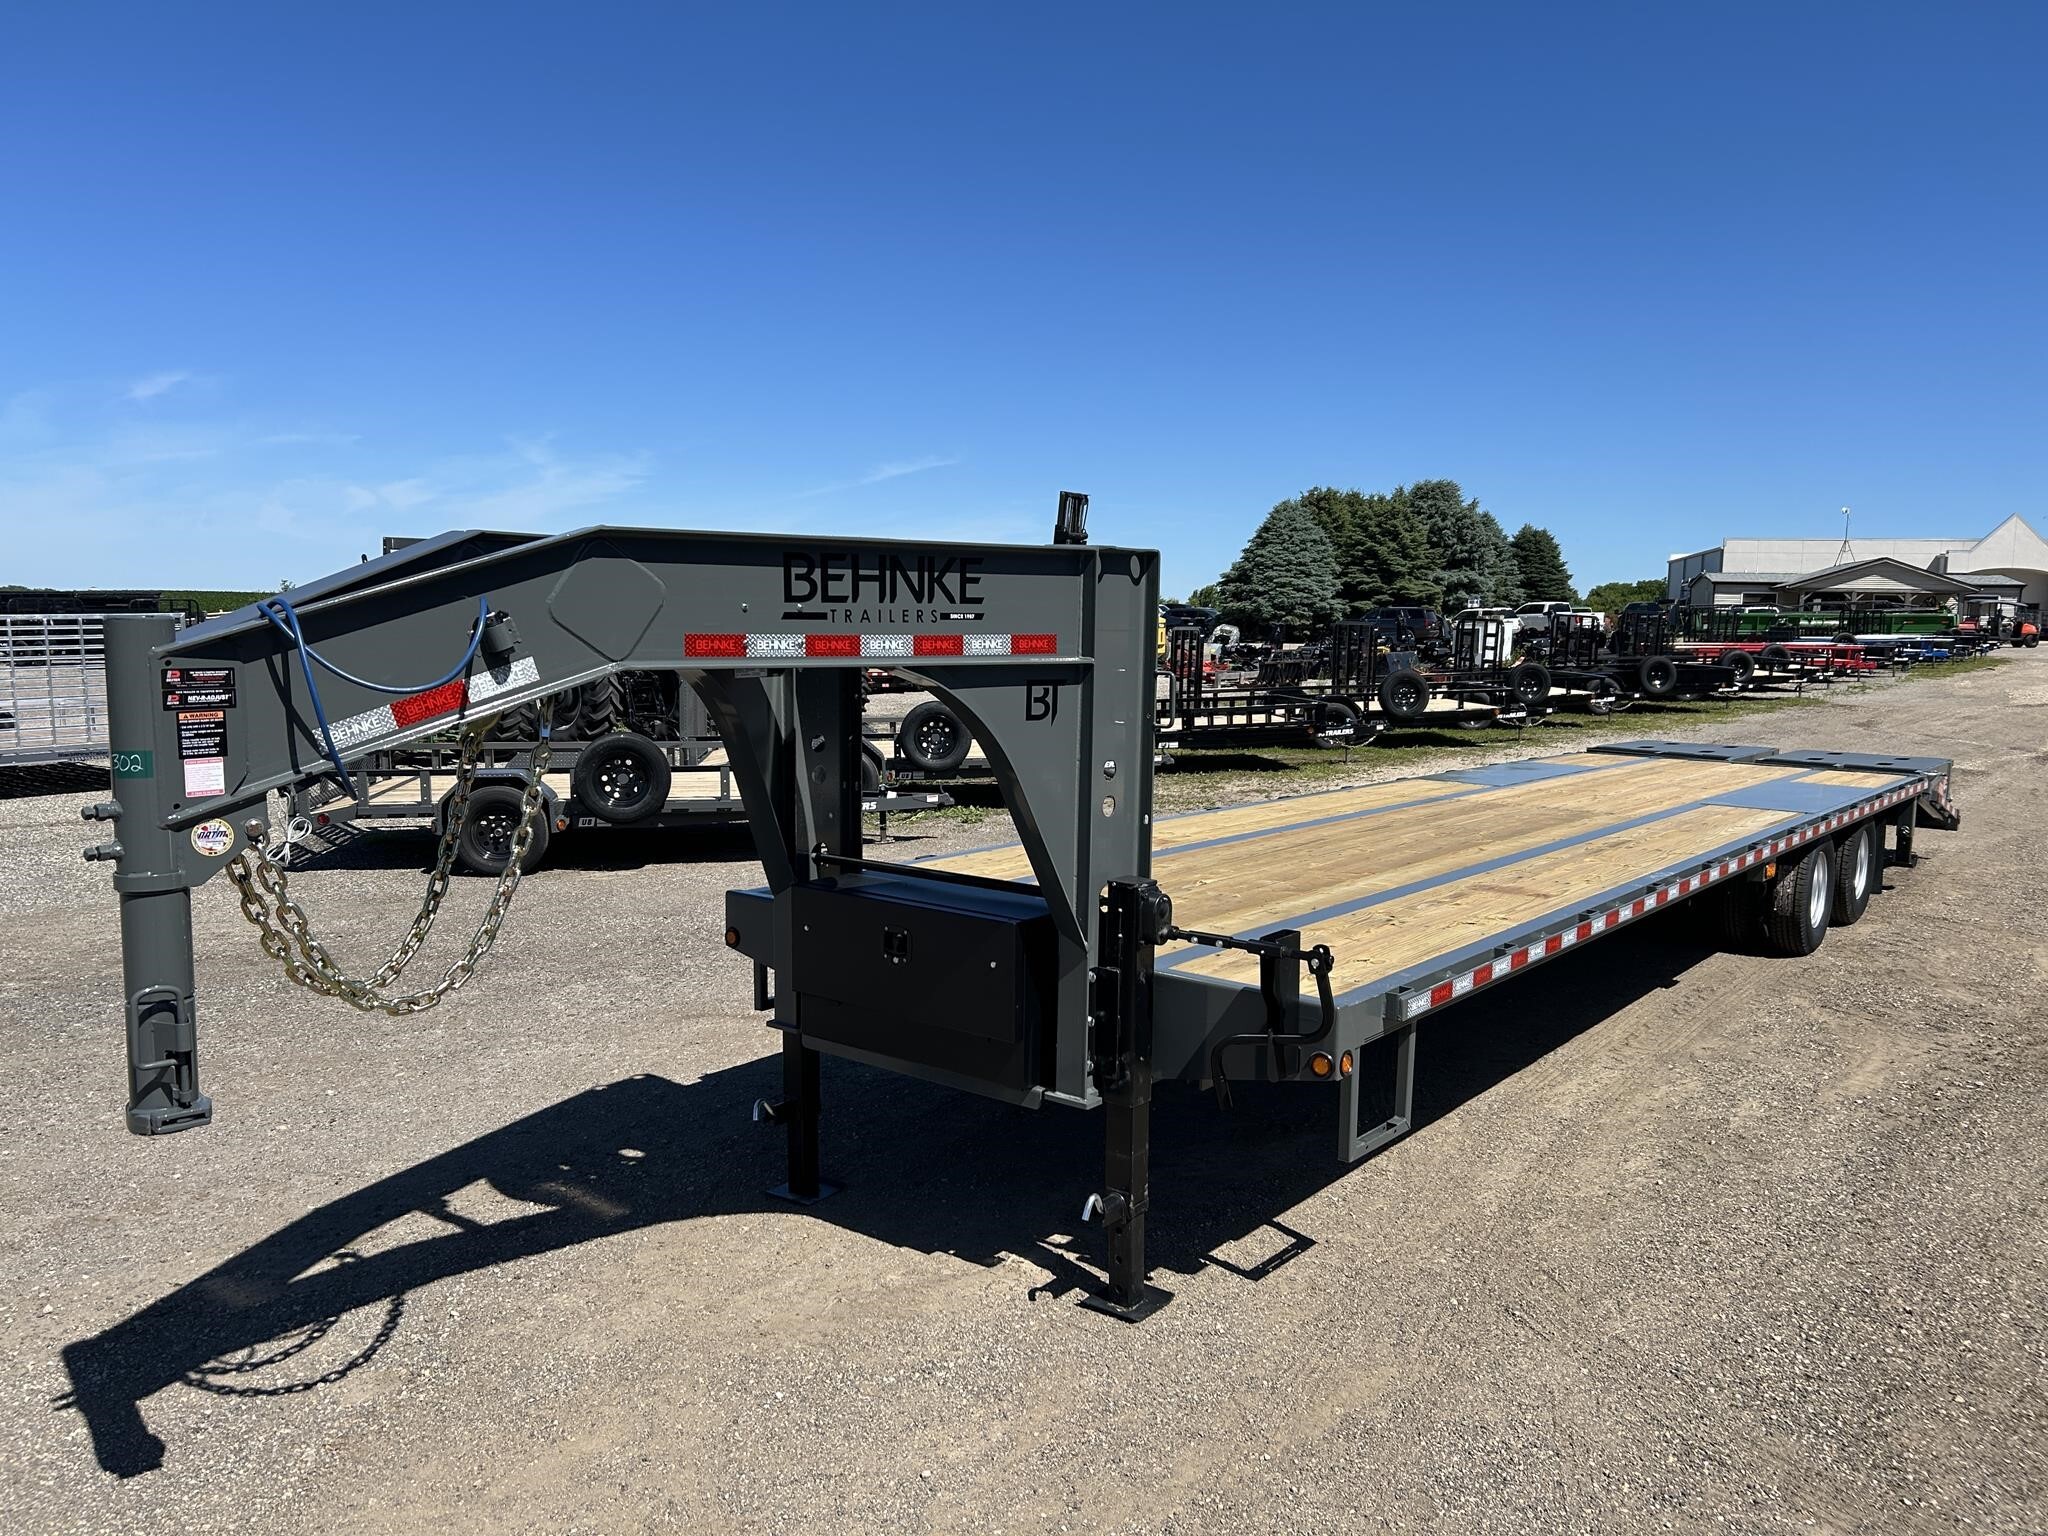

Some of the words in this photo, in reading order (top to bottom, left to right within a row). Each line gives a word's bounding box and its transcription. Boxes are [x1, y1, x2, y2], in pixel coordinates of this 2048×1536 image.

[783, 552, 984, 604] BEHNKE
[830, 609, 938, 623] TRAILERS
[696, 640, 735, 650] BEHNKE
[757, 640, 795, 650] BEHNKE
[815, 640, 850, 650] BEHNKE
[870, 640, 904, 649] BEHNKE
[923, 640, 954, 648] BEHNKE
[972, 639, 1003, 648] BEHNKE
[1019, 639, 1048, 648] BEHNKE
[405, 692, 455, 716] BEHNKE
[330, 715, 382, 743] BEHNKE
[112, 753, 144, 773] 302
